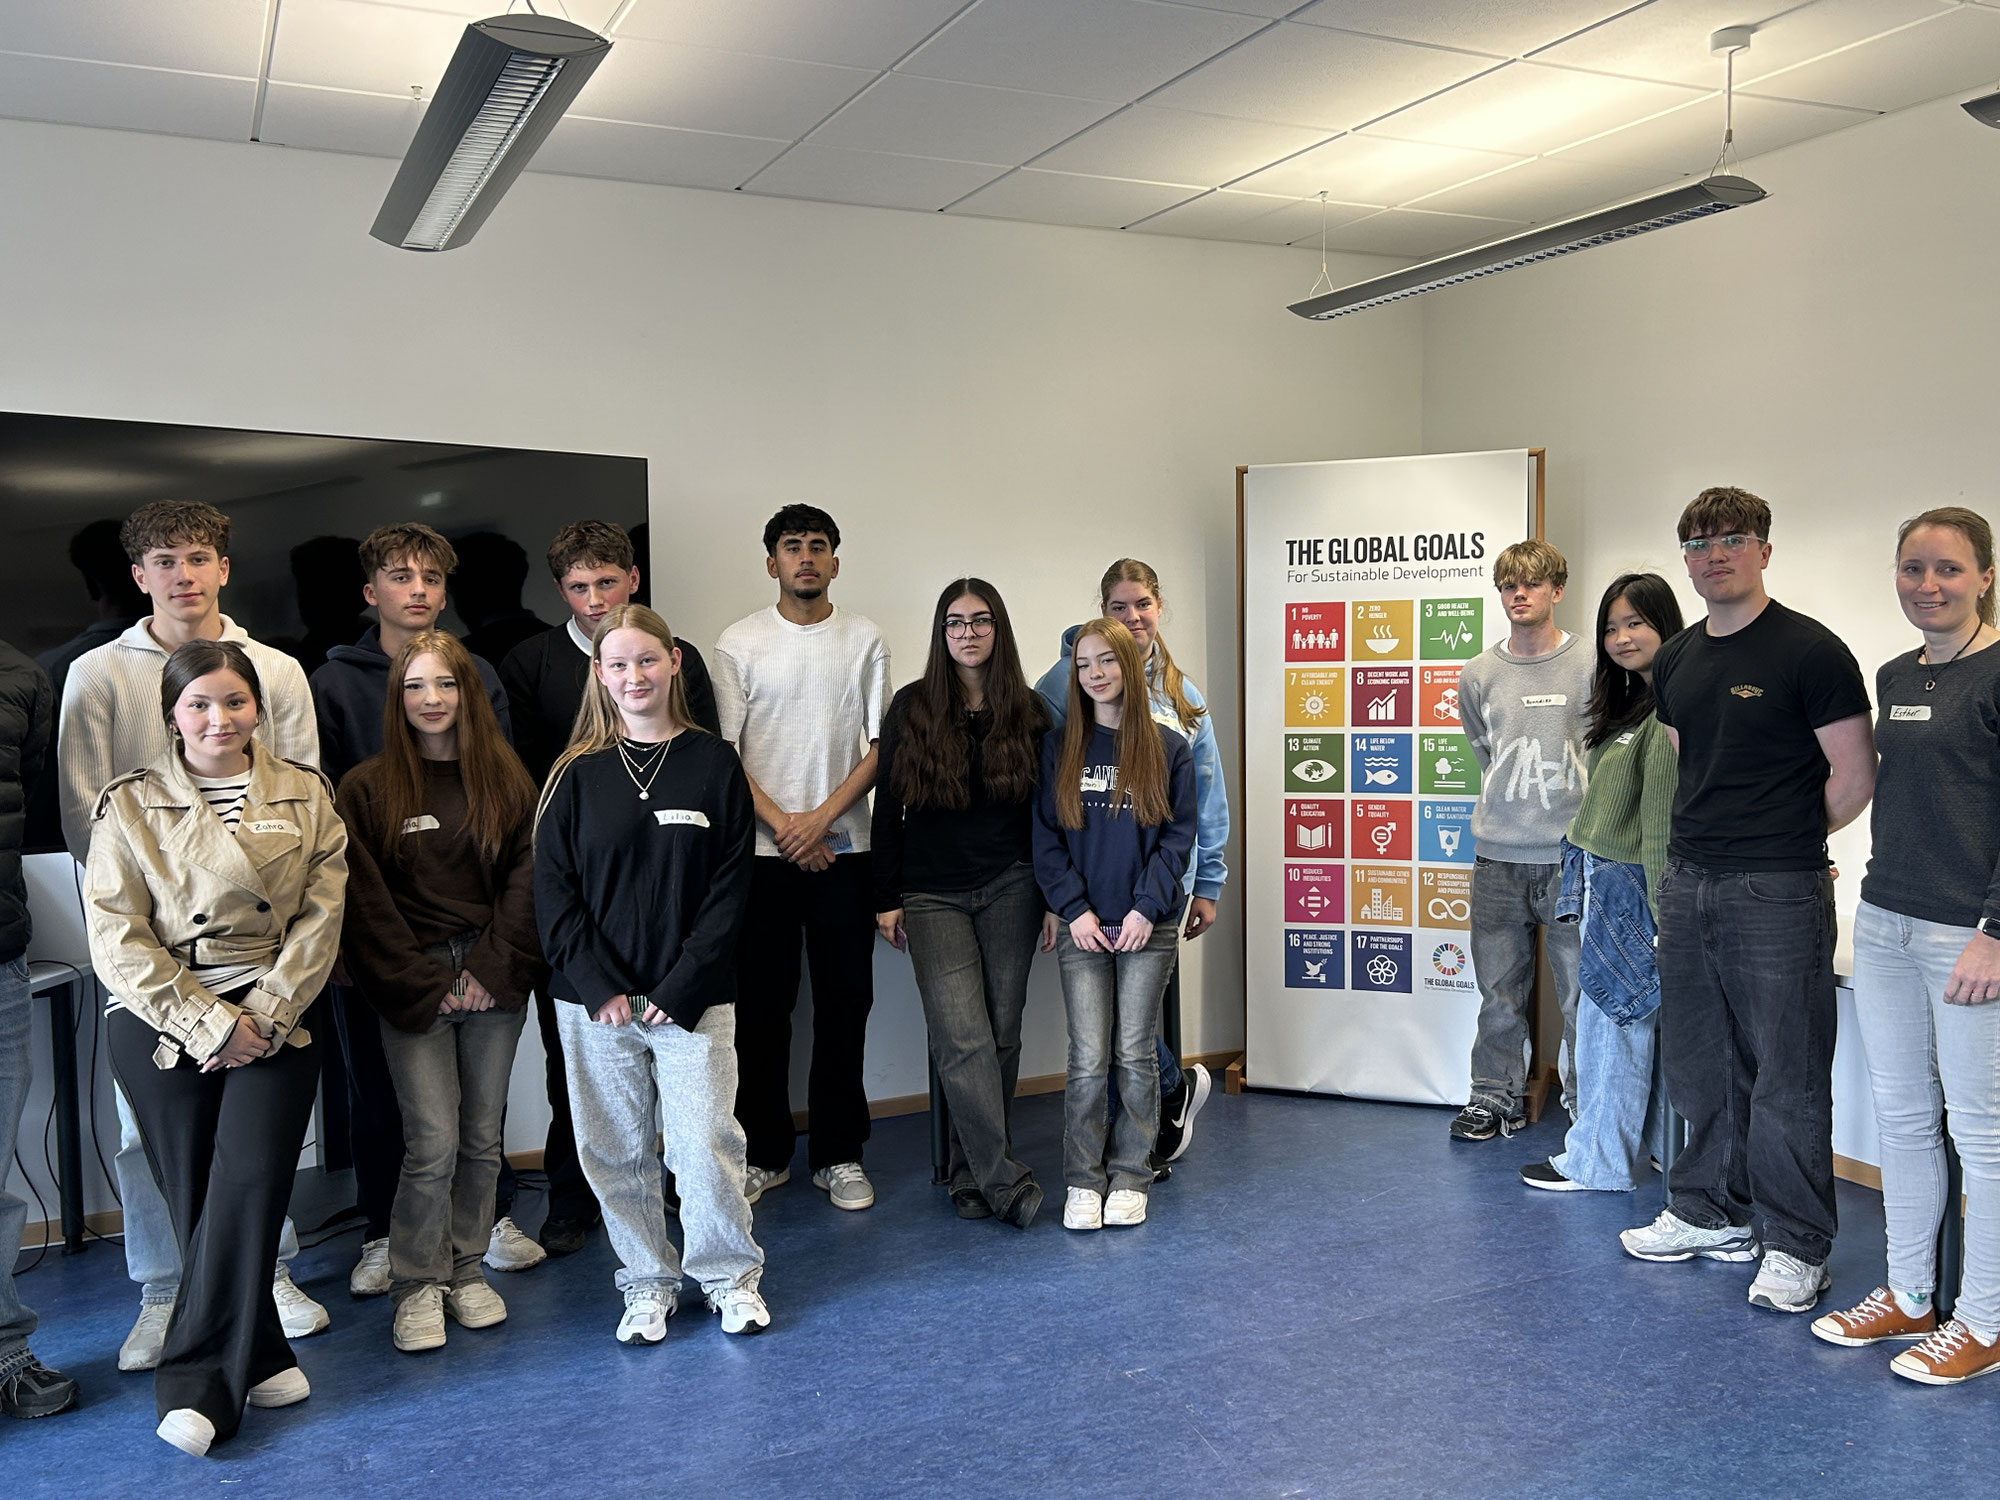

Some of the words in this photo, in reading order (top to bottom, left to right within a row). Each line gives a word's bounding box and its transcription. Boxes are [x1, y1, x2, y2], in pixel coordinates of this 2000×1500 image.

[1286, 539, 1324, 566] THE
[1328, 536, 1409, 565] GLOBAL
[1414, 532, 1485, 562] GOALS
[1288, 570, 1308, 583] For
[1311, 567, 1390, 583] Sustainable
[1393, 565, 1484, 582] Development
[1291, 607, 1297, 621] 1
[1301, 613, 1322, 621] POVERTY
[1357, 605, 1365, 619] 2
[1425, 603, 1433, 618] 3
[1290, 672, 1297, 686] 7
[1356, 671, 1364, 686] 8
[1423, 670, 1431, 684] 9
[1892, 707, 1921, 718] Esther
[1288, 737, 1300, 751] 13
[1355, 738, 1367, 752] 14
[1423, 738, 1435, 752] 15
[1290, 803, 1297, 817] 4
[1356, 803, 1364, 817] 5
[1424, 805, 1432, 819] 6
[1436, 805, 1450, 813] CLEAN
[663, 812, 692, 821] Lilia
[254, 823, 284, 831] Zahra
[1288, 867, 1300, 881] 10
[1354, 869, 1365, 883] 11
[1422, 871, 1434, 886] 12
[1288, 933, 1300, 947] 16
[1356, 935, 1367, 949] 17
[1424, 977, 1434, 985] THE
[1434, 978, 1455, 987] GLOBAL
[1455, 980, 1475, 989] GOALS
